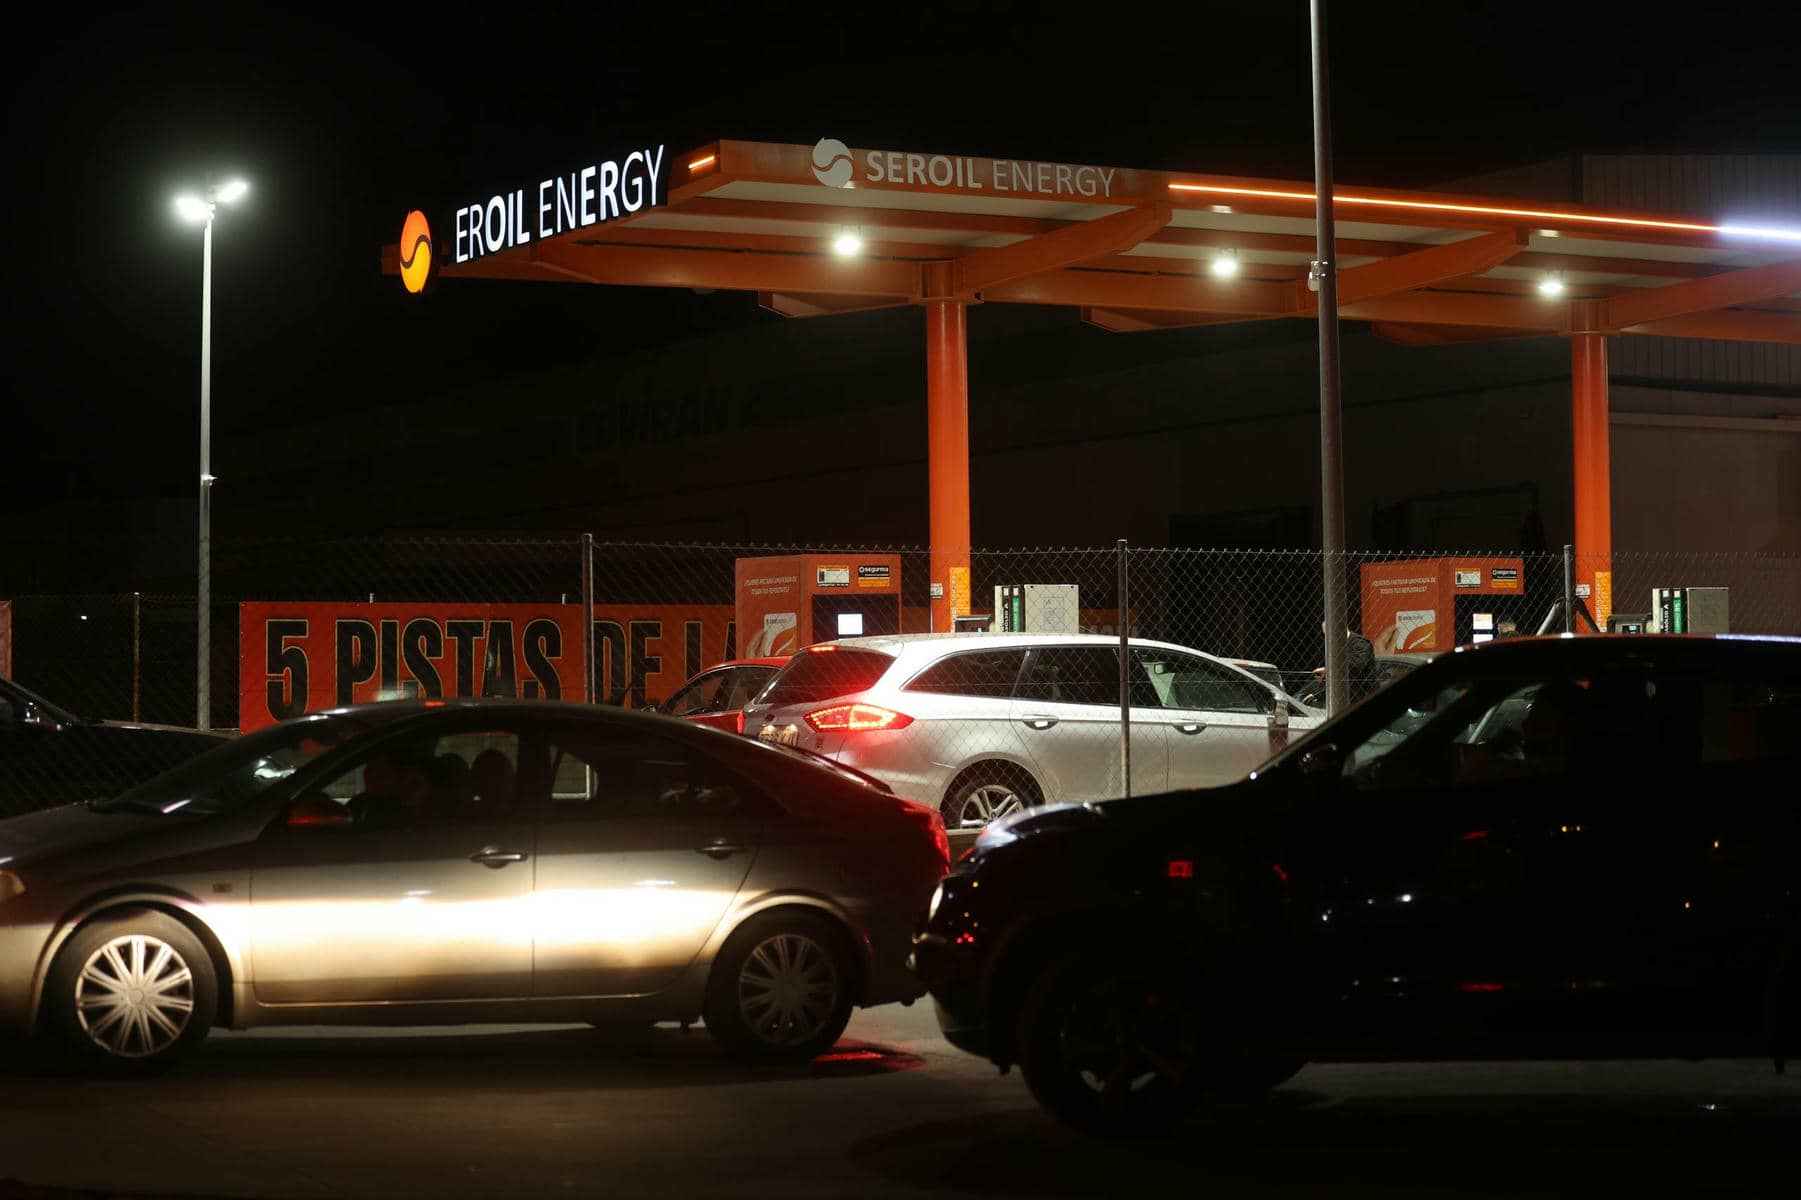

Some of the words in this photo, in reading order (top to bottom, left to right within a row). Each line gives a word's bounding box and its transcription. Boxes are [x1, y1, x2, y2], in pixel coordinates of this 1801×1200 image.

[455, 189, 531, 264] EROIL
[539, 144, 664, 239] ENERGY
[865, 150, 984, 189] SEROIL
[992, 158, 1116, 198] ENERGY
[265, 618, 310, 722] 5
[335, 617, 563, 705] PISTAS
[592, 619, 664, 707] DE
